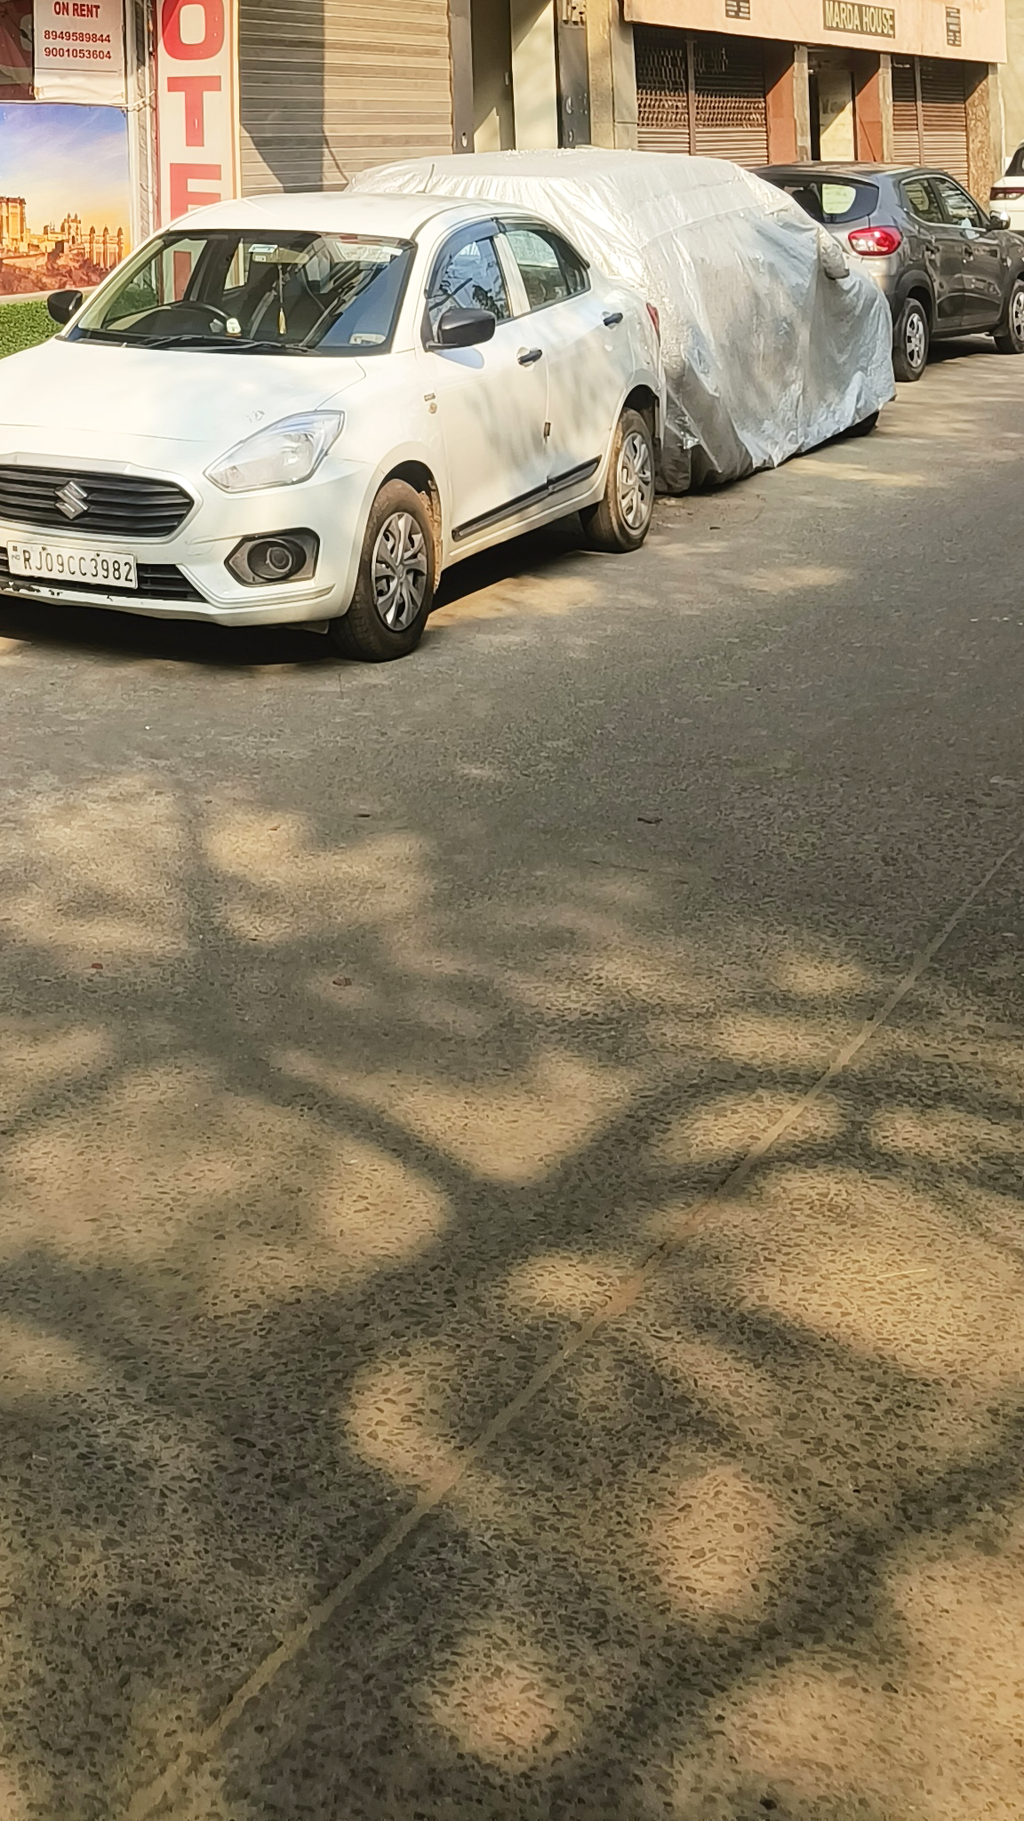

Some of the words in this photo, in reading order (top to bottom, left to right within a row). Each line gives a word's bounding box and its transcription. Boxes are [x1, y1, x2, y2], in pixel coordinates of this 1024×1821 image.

[53, 1, 69, 16] ON
[72, 3, 100, 18] RENT
[825, 0, 861, 31] MARDA
[862, 6, 894, 35] HOUSE
[43, 29, 111, 44] 8949589844
[43, 46, 112, 60] 9001053604
[22, 549, 134, 582] RJ09CC3982
